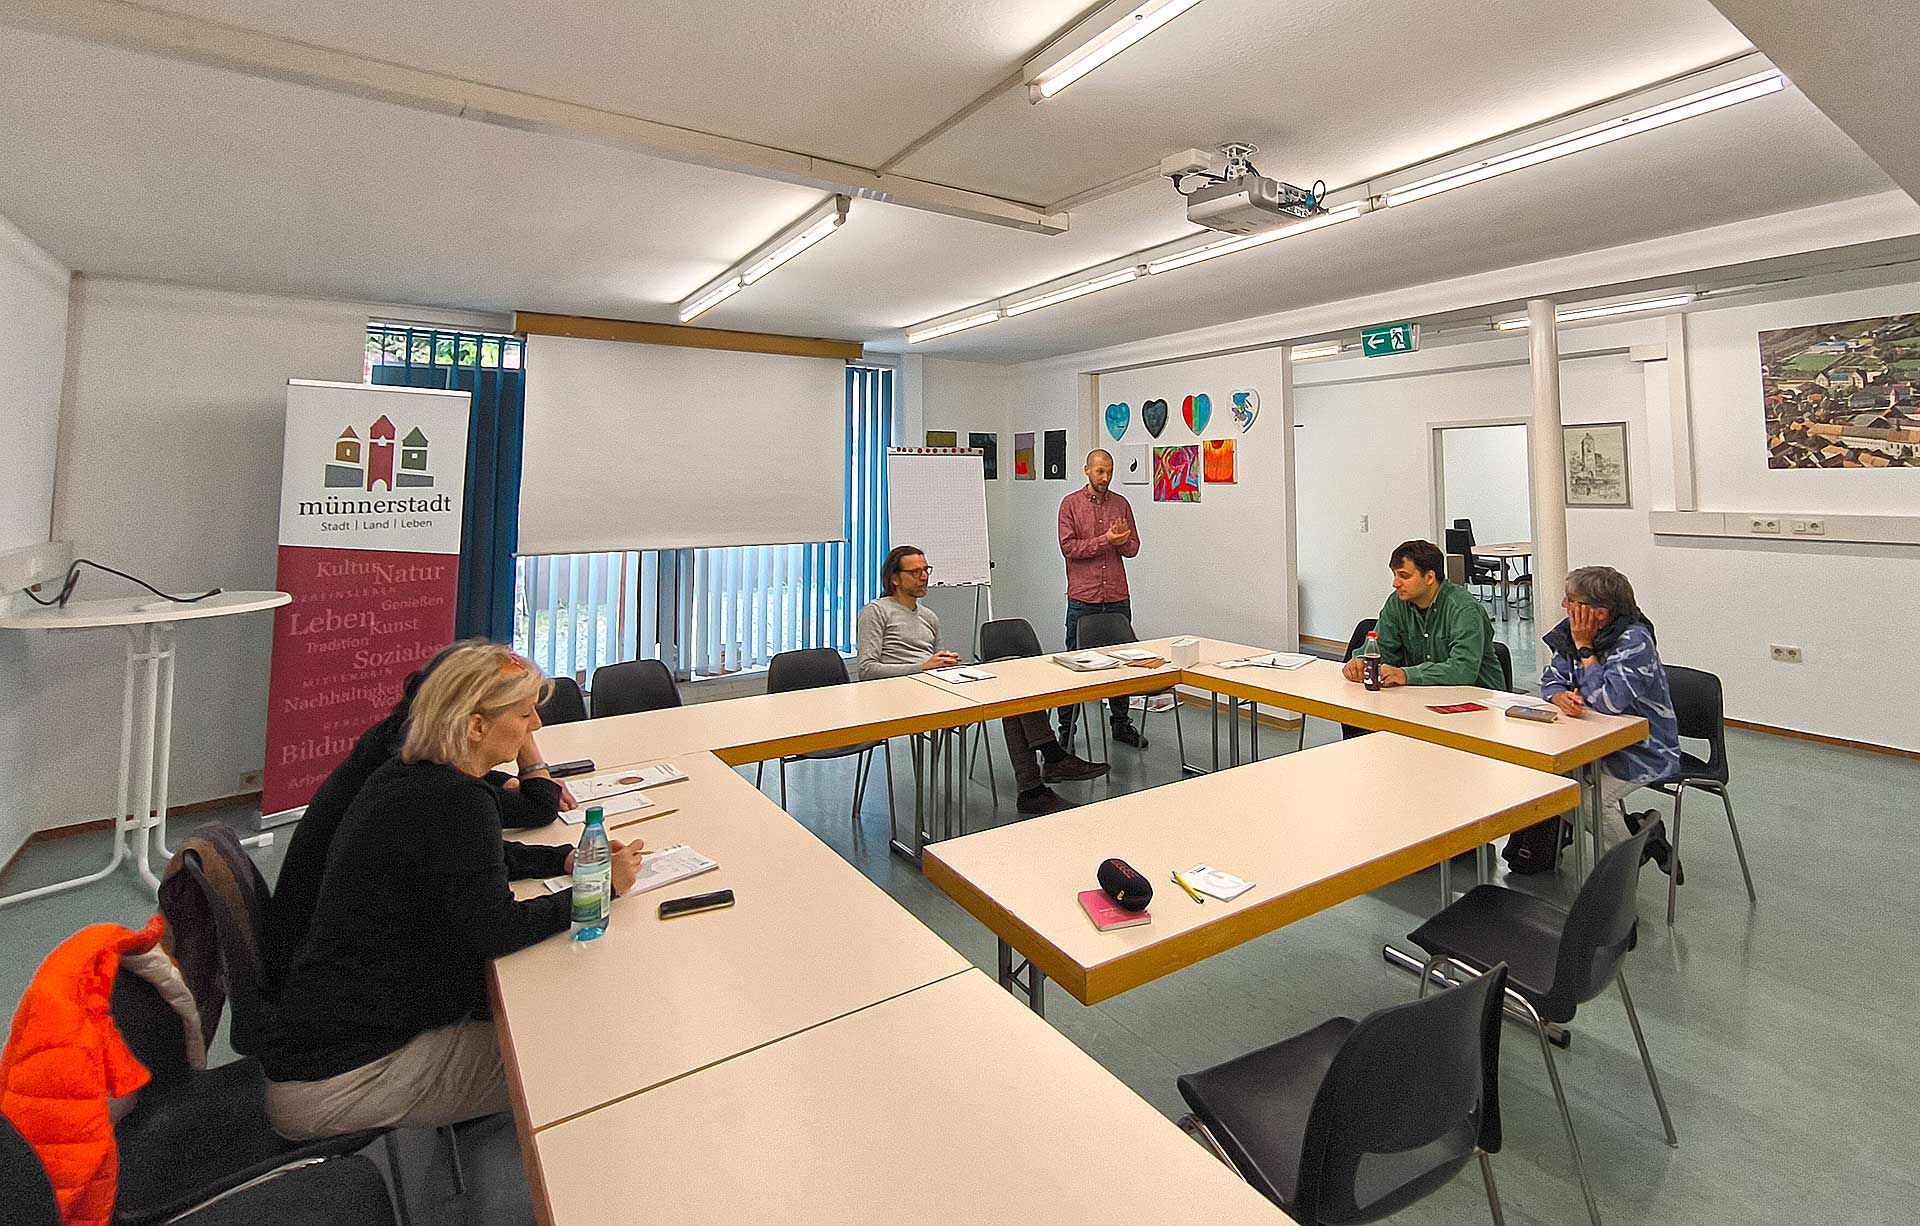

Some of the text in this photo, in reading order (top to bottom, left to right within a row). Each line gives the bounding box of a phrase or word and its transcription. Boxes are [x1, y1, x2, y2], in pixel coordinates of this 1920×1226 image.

[299, 494, 451, 515] münnerstadt
[321, 521, 351, 532] Stadt
[363, 519, 390, 530] Land
[401, 518, 433, 529] Leben
[373, 564, 445, 585] Natur
[289, 608, 376, 636] Leben
[369, 617, 419, 636] Kunst
[306, 637, 370, 654] Tradition
